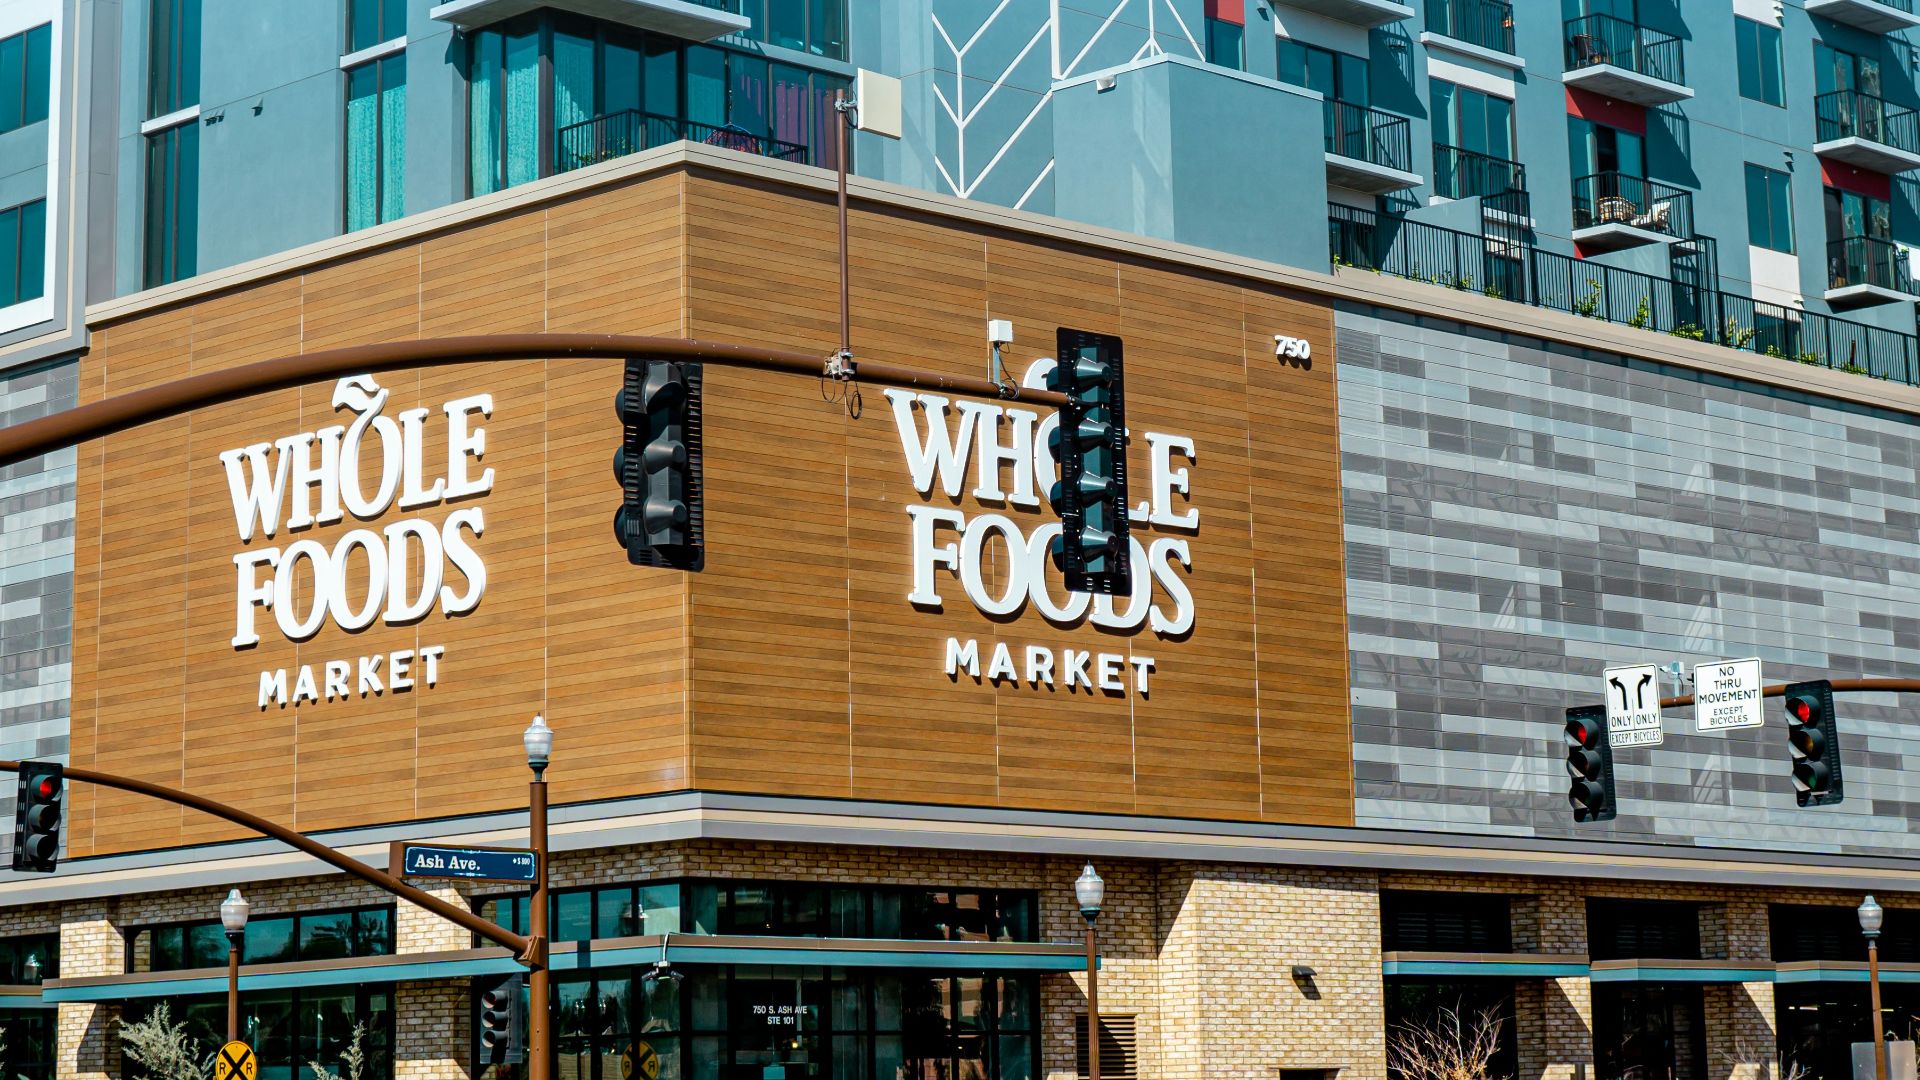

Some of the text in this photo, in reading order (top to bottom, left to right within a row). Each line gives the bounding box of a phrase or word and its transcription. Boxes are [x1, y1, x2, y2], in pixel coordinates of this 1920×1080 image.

[1274, 334, 1311, 360] 750
[884, 358, 1199, 529] WHE
[219, 374, 495, 541] WHOLE
[231, 507, 487, 647] FOODS
[945, 637, 1156, 694] MARKET
[1719, 666, 1735, 677] NO
[258, 645, 445, 708] MARKET
[1713, 677, 1742, 690] THRU
[1699, 689, 1758, 704] MOVEMENT
[1713, 705, 1743, 716] EXCEPT
[1611, 715, 1632, 728] ONLY
[1635, 712, 1657, 725] ONLY
[1710, 714, 1748, 726] BICYCLES
[1611, 730, 1660, 745] EXCEPT BICYCLES
[414, 854, 481, 871] Ash Ave.
[753, 1005, 808, 1014] 750 S. ASH AVE
[767, 1016, 794, 1025] STE 101
[220, 1062, 252, 1074] R R
